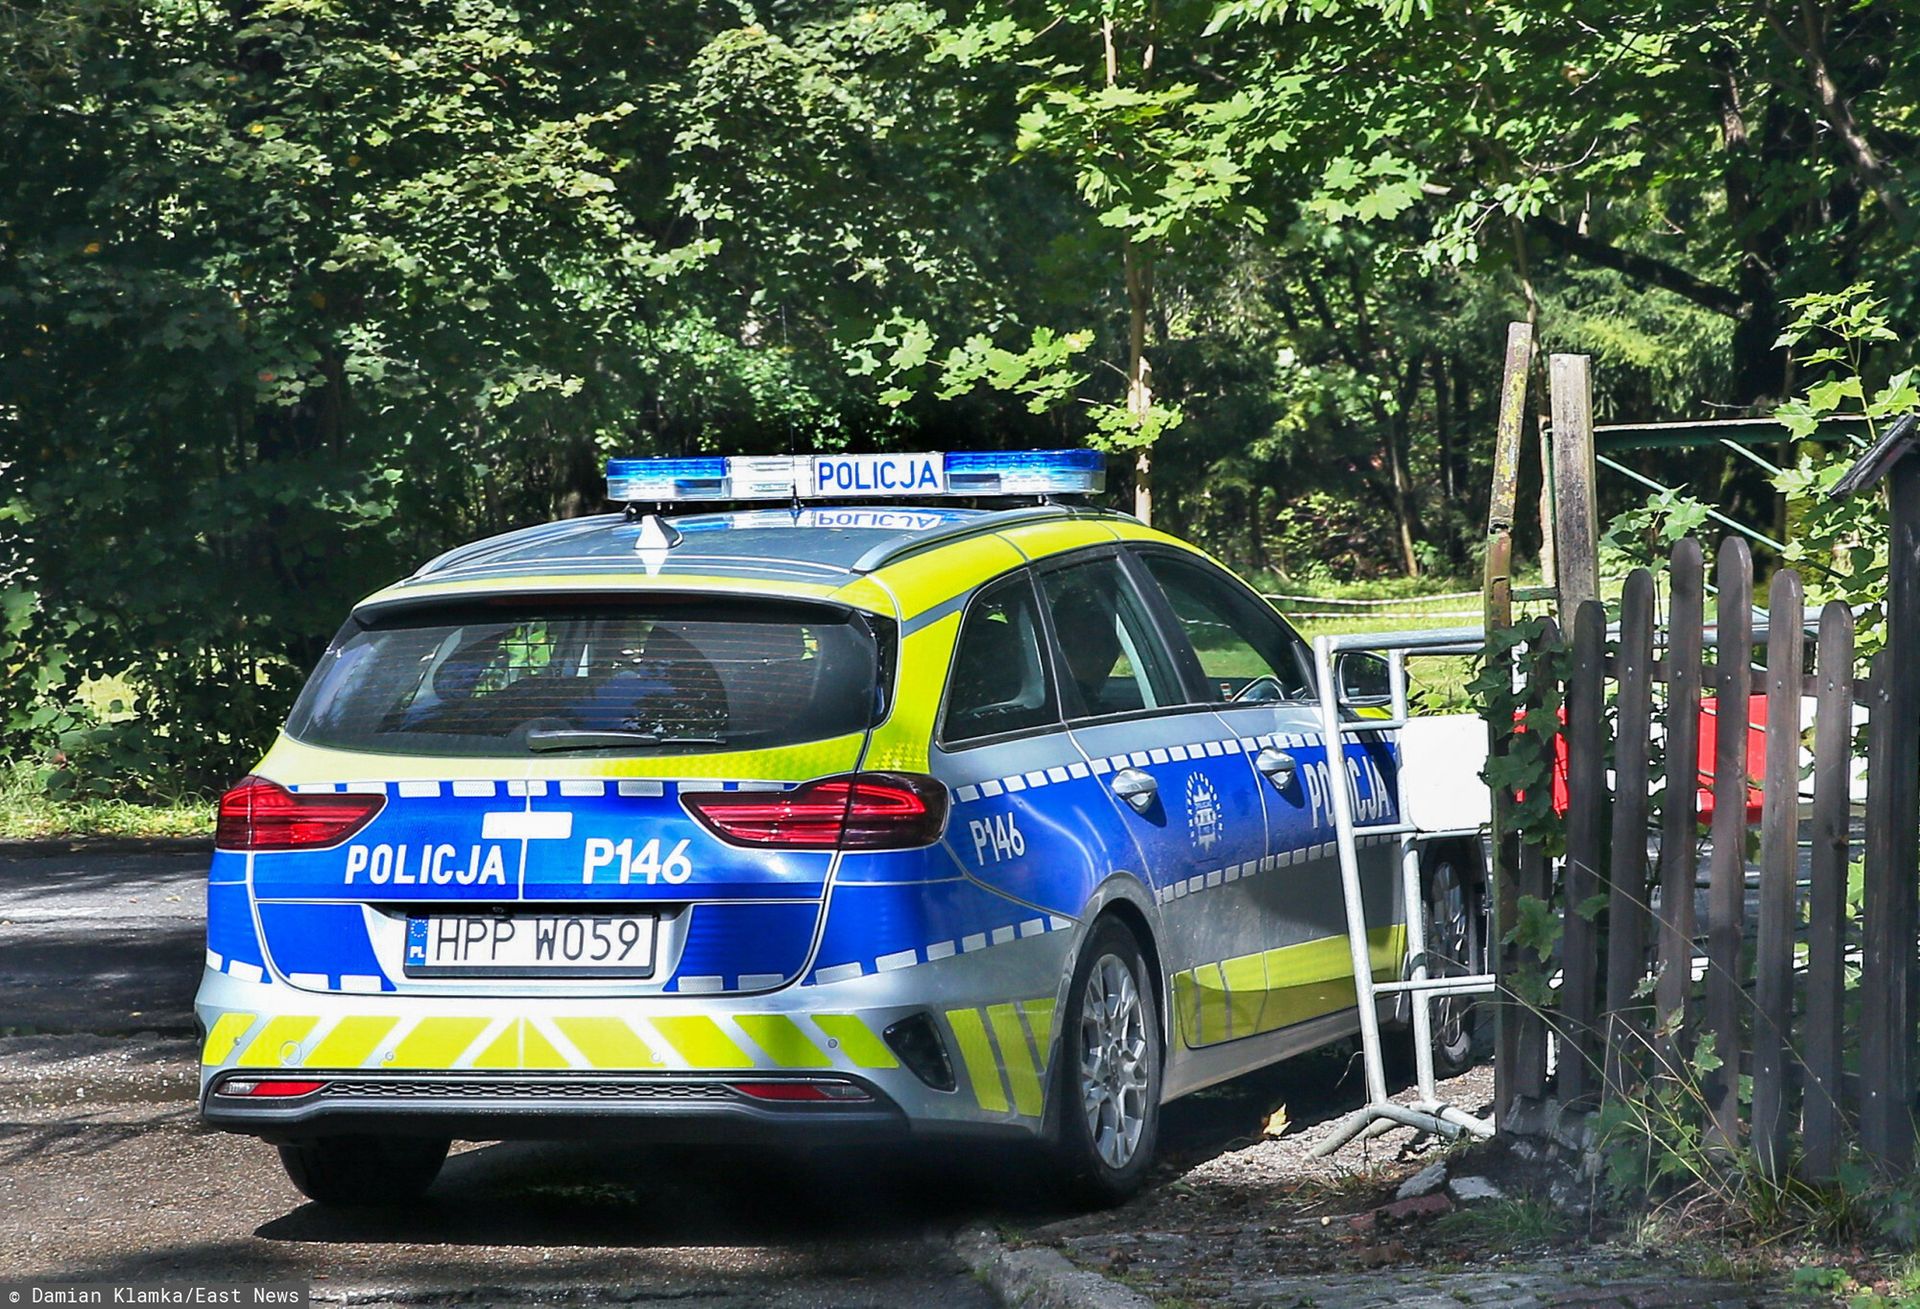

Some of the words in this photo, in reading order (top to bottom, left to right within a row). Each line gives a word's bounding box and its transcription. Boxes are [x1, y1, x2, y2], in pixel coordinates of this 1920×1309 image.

[819, 461, 937, 490] POLICJA
[1303, 756, 1391, 829] POICJA
[969, 812, 1025, 866] P146
[344, 844, 506, 885] POLICJA
[582, 838, 693, 885] P146
[409, 946, 425, 958] PL
[435, 919, 515, 961] HPP
[535, 919, 640, 961] W059
